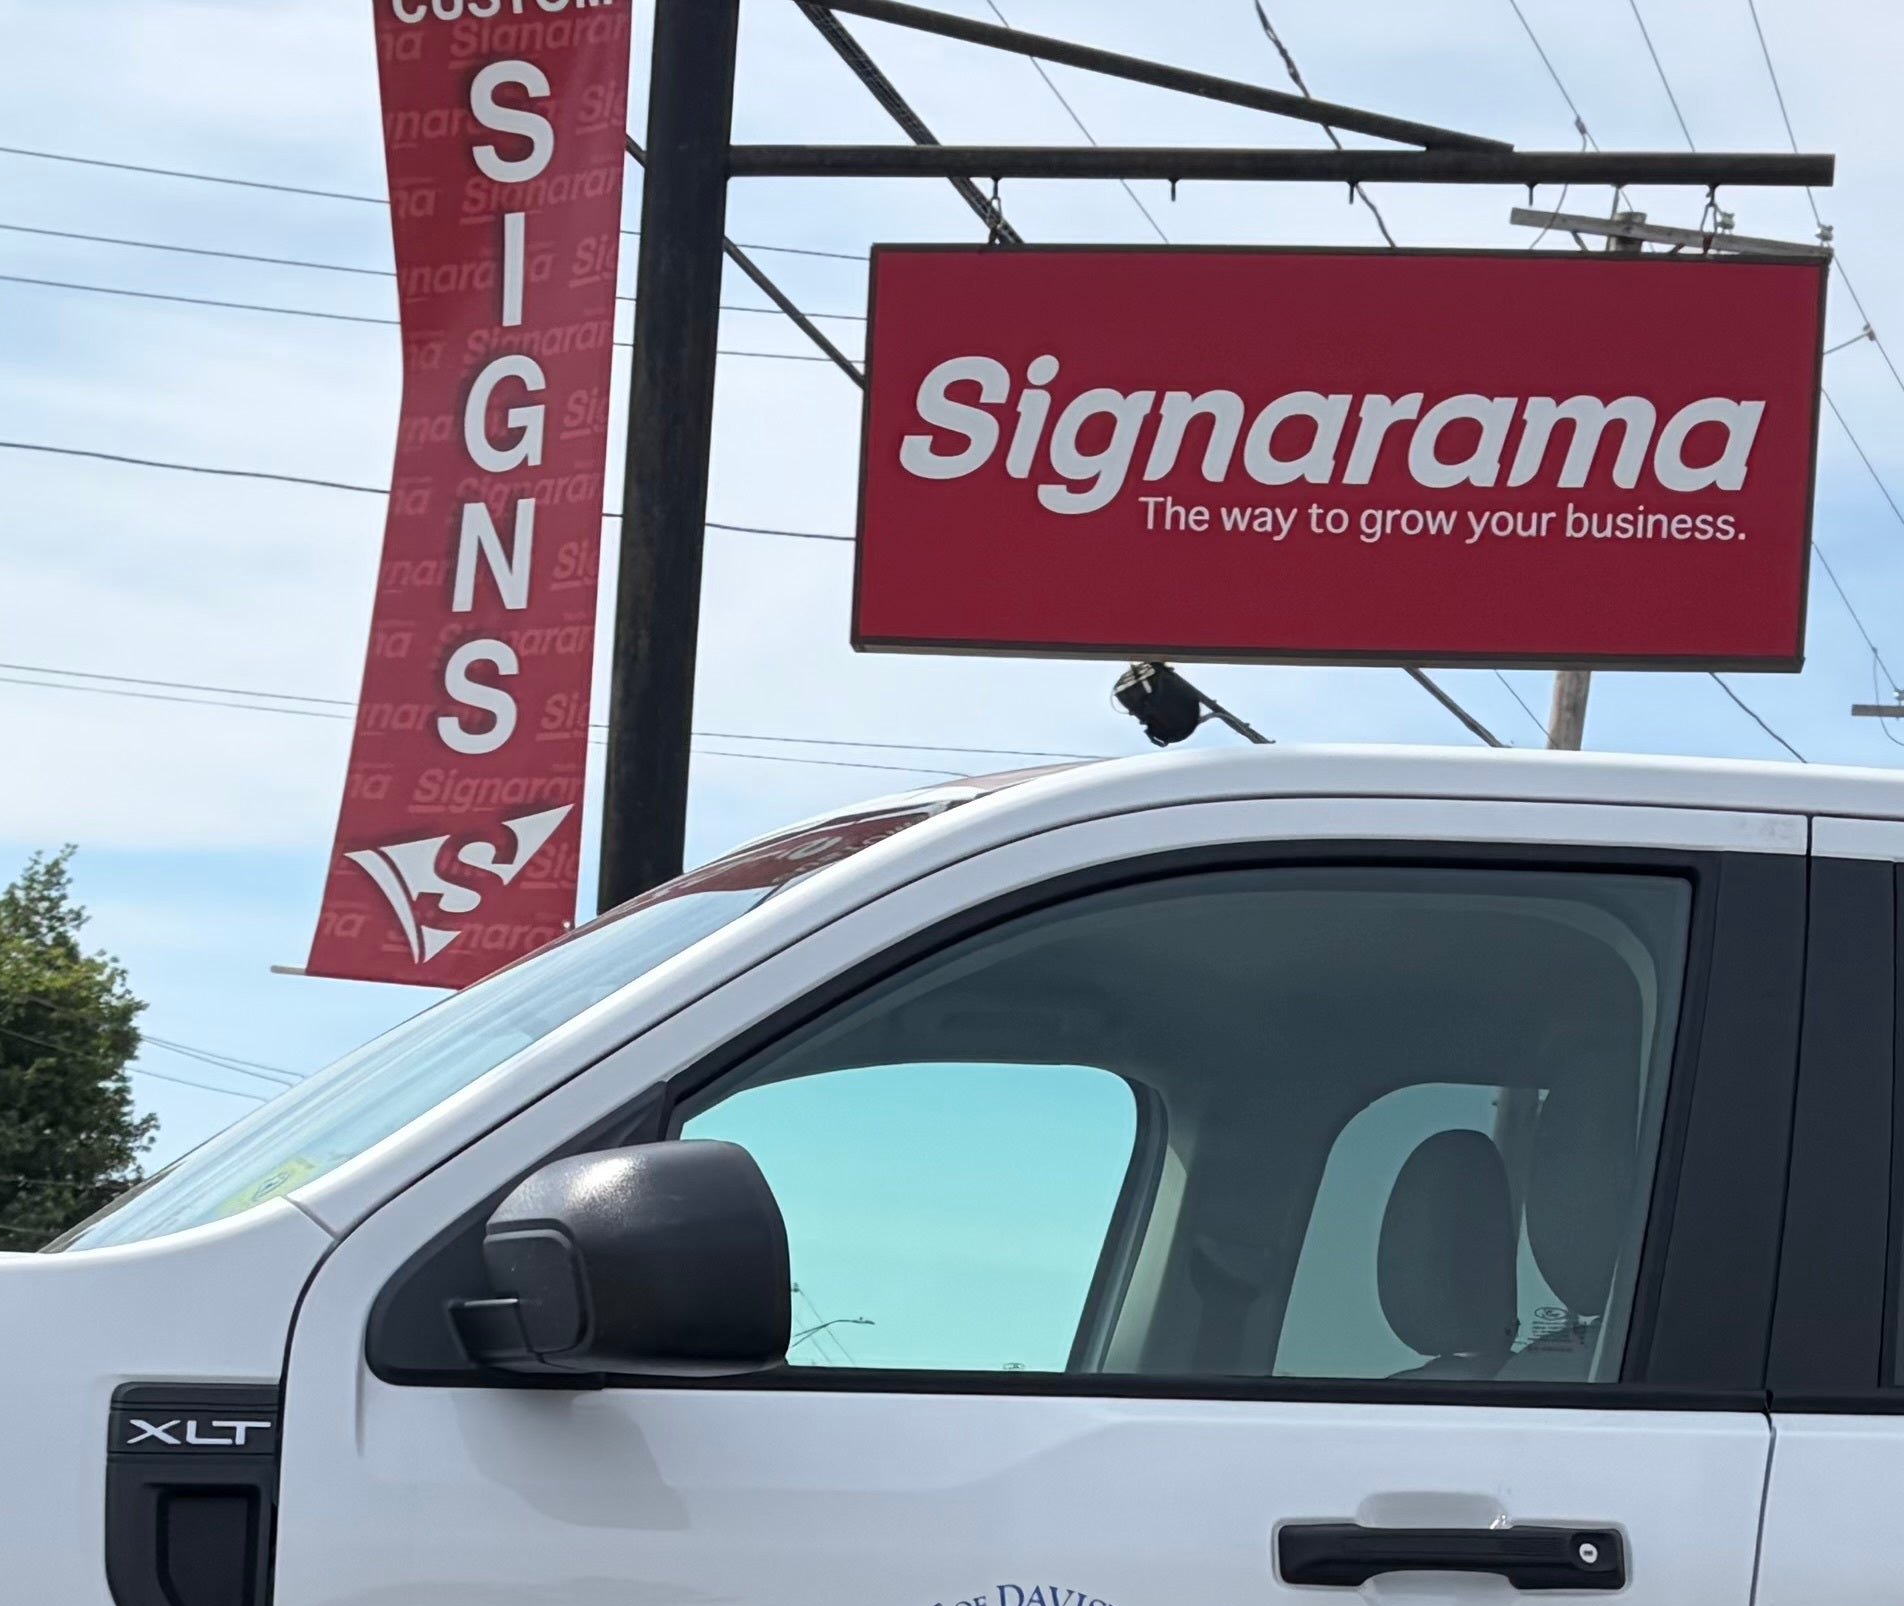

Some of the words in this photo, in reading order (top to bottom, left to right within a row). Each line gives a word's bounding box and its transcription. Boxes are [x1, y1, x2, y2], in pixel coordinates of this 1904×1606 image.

[437, 59, 555, 755] SIGNS
[899, 354, 1767, 515] Signarama
[1138, 495, 1211, 532] The
[1220, 507, 1298, 541] way
[1307, 503, 1349, 534] to
[1360, 508, 1458, 543] grow
[1465, 511, 1557, 544] your
[1565, 502, 1747, 541] business.
[127, 1419, 272, 1445] XLT
